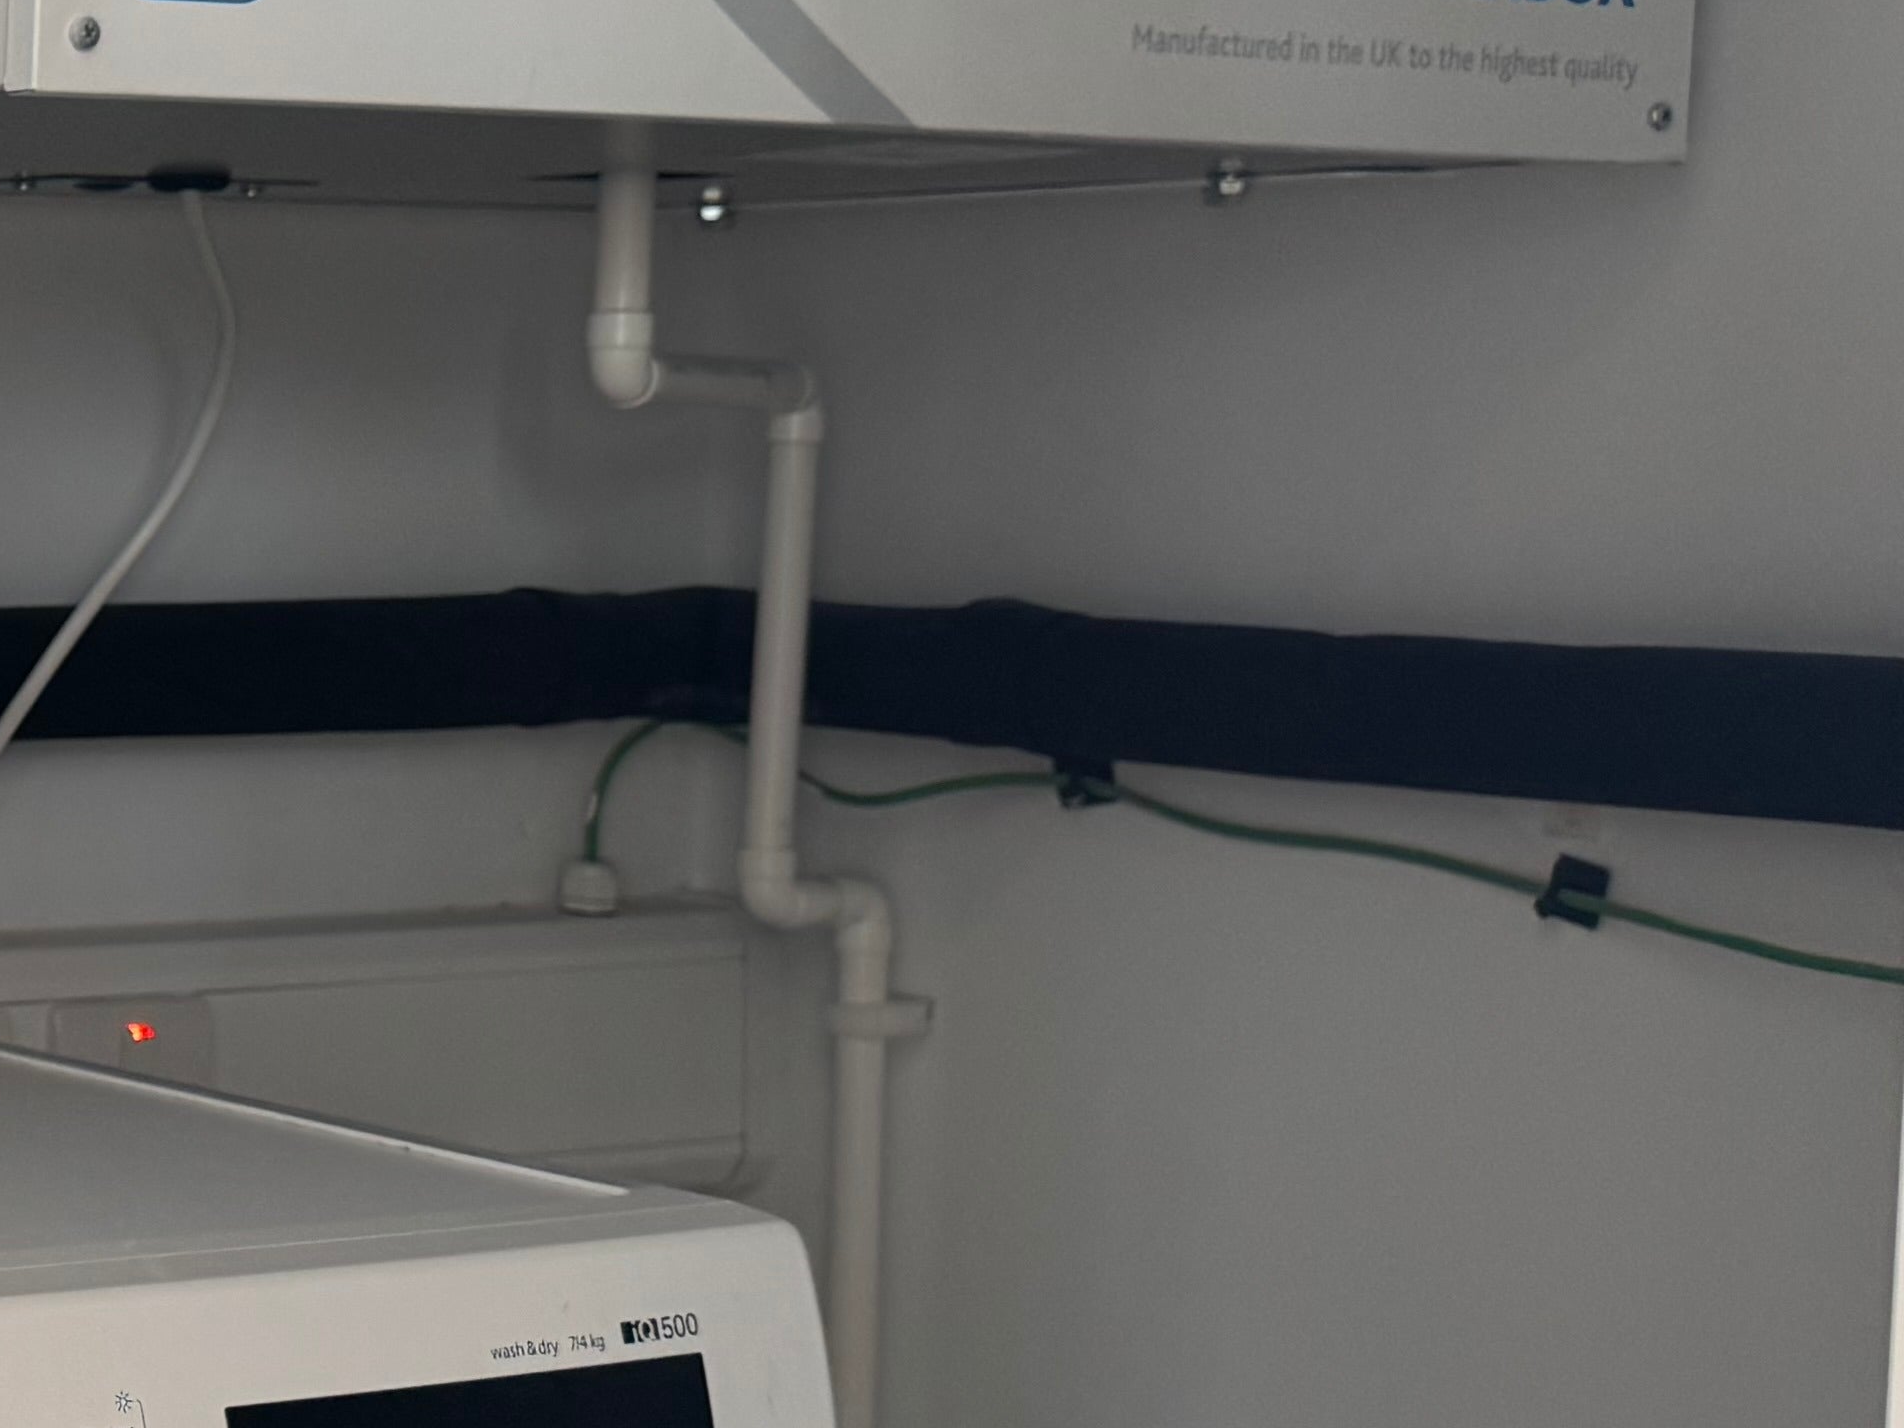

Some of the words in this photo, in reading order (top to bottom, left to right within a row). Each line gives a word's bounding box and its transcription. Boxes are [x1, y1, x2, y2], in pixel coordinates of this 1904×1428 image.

[1131, 23, 1293, 63] Manufactured
[1299, 33, 1321, 63] in
[1327, 34, 1365, 67] the
[1370, 39, 1401, 68] UK
[1408, 42, 1432, 71] to
[1438, 44, 1476, 73] the
[1482, 47, 1558, 84] highest
[1564, 53, 1638, 89] quality
